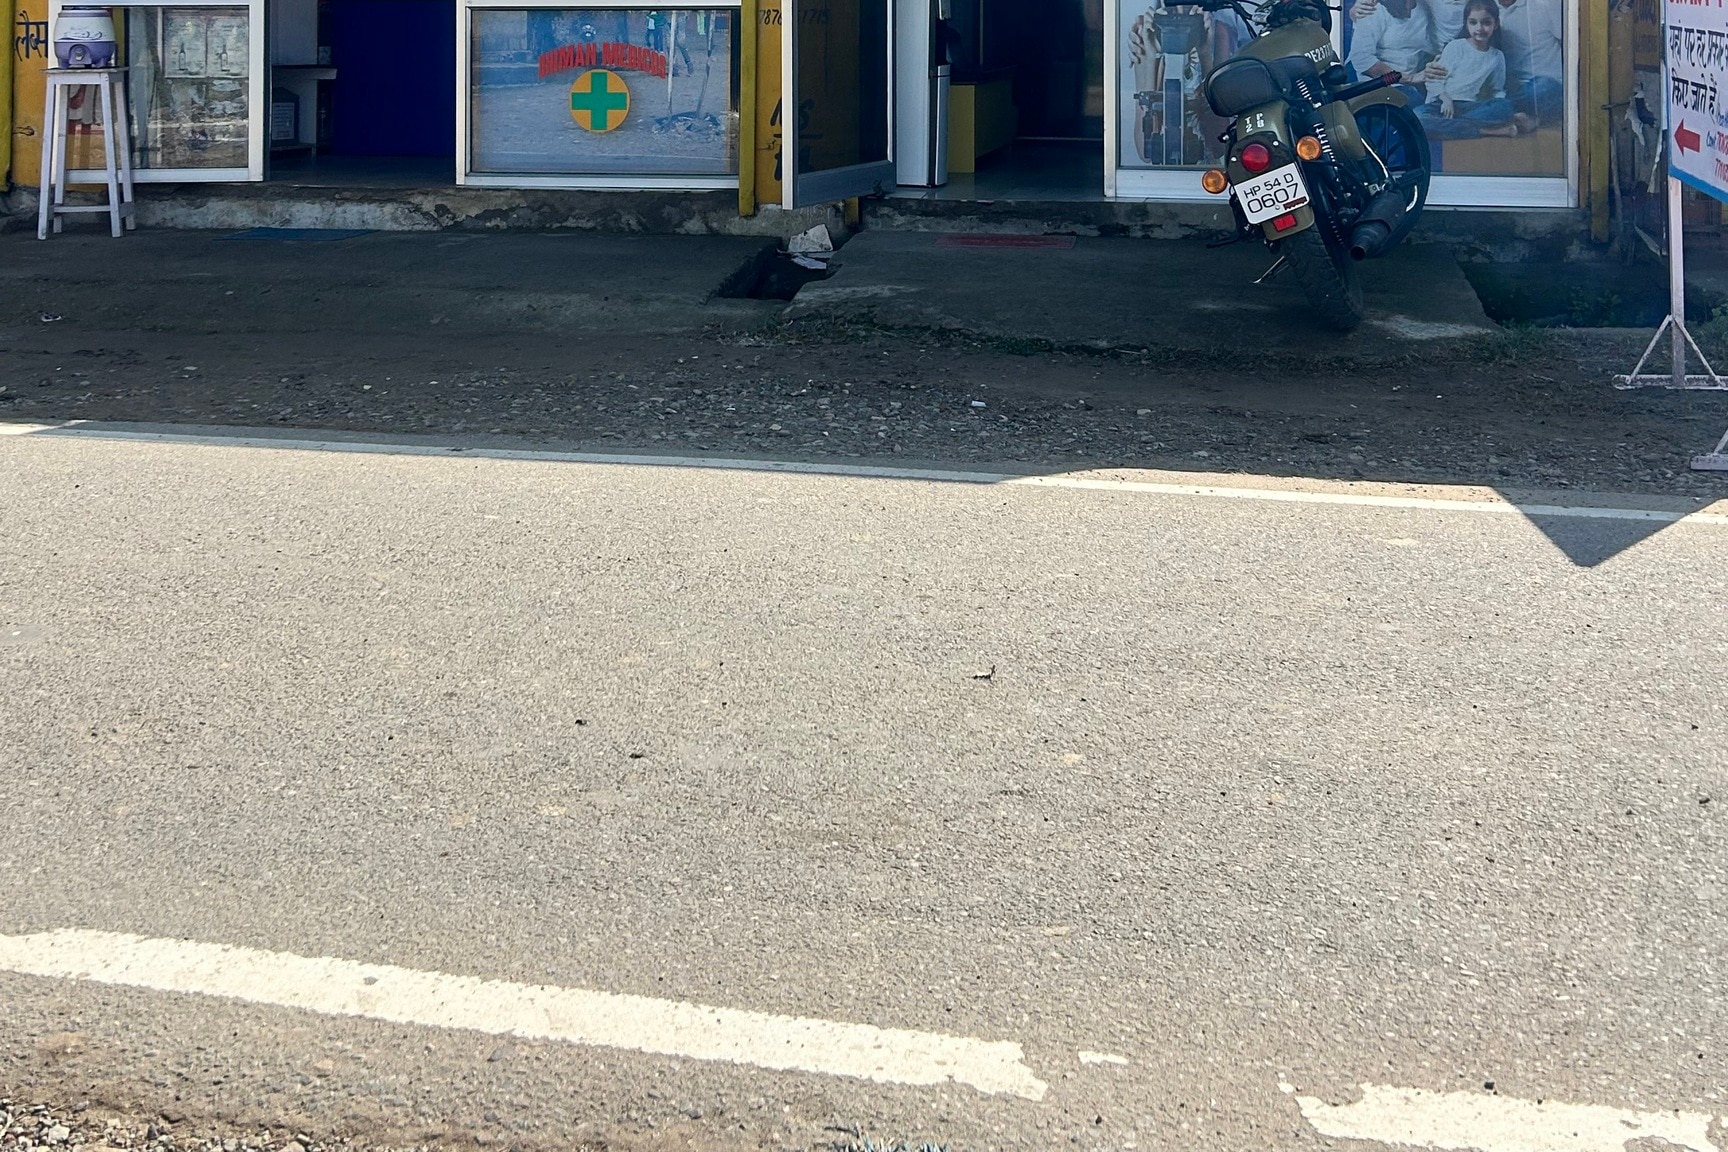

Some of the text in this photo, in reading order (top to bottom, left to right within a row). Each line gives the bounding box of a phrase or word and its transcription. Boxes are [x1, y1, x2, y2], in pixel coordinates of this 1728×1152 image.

[1243, 173, 1294, 199] HP 54 D
[1247, 183, 1299, 214] 0607
